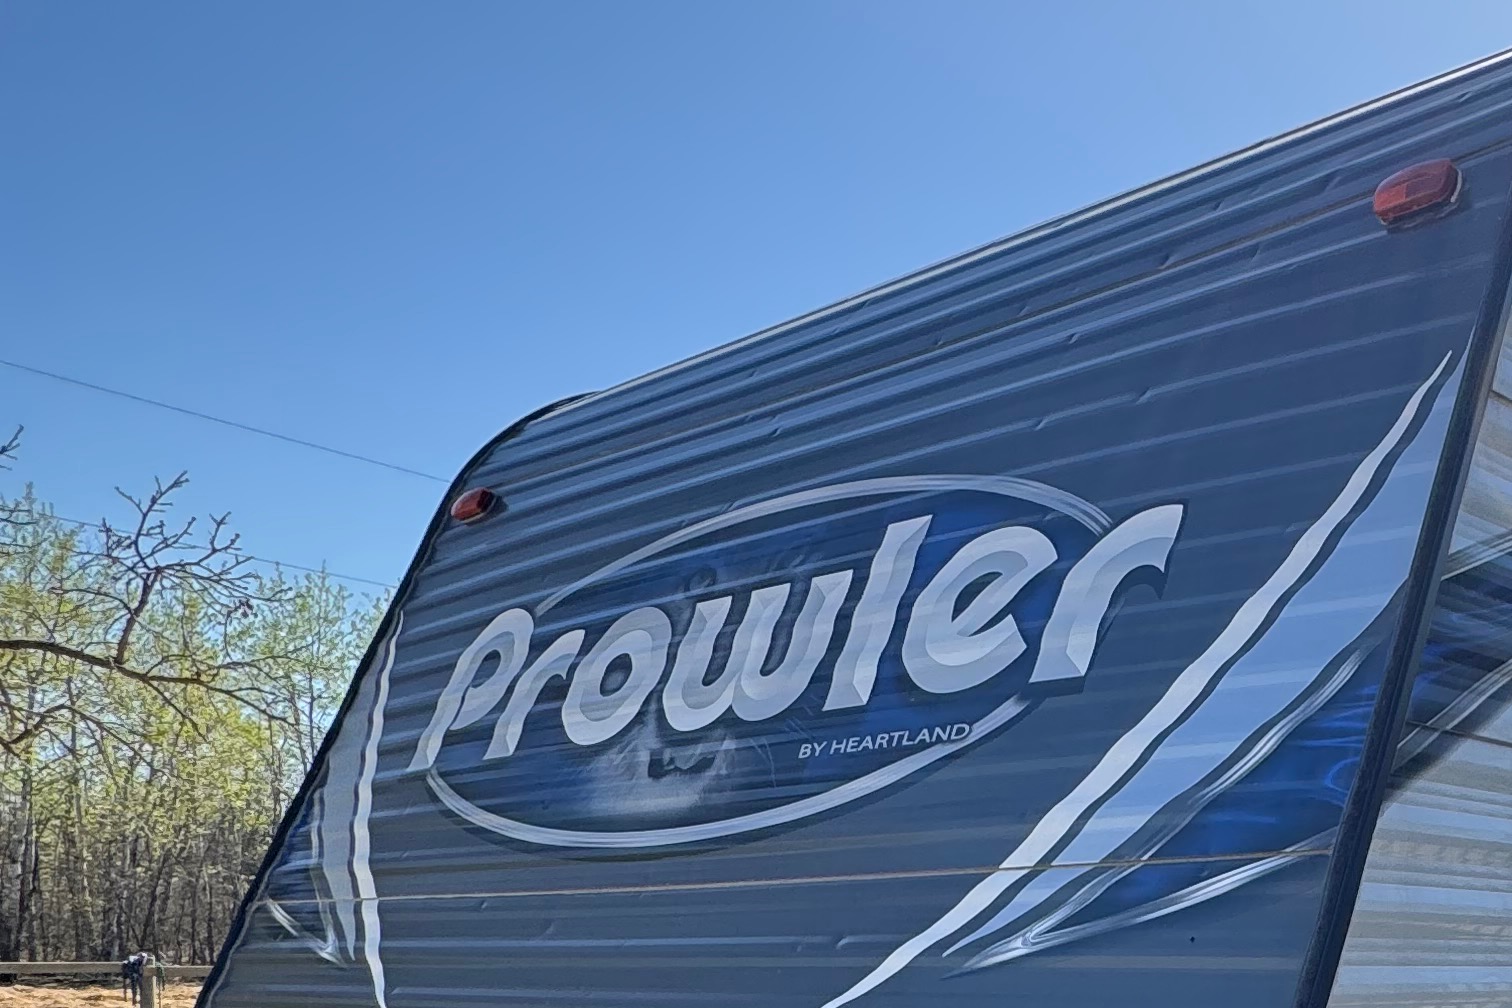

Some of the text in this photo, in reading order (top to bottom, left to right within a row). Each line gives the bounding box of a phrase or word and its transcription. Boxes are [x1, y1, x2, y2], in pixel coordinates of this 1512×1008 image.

[405, 504, 1184, 772] Prowler
[798, 723, 971, 759] BY HEARTLAND
